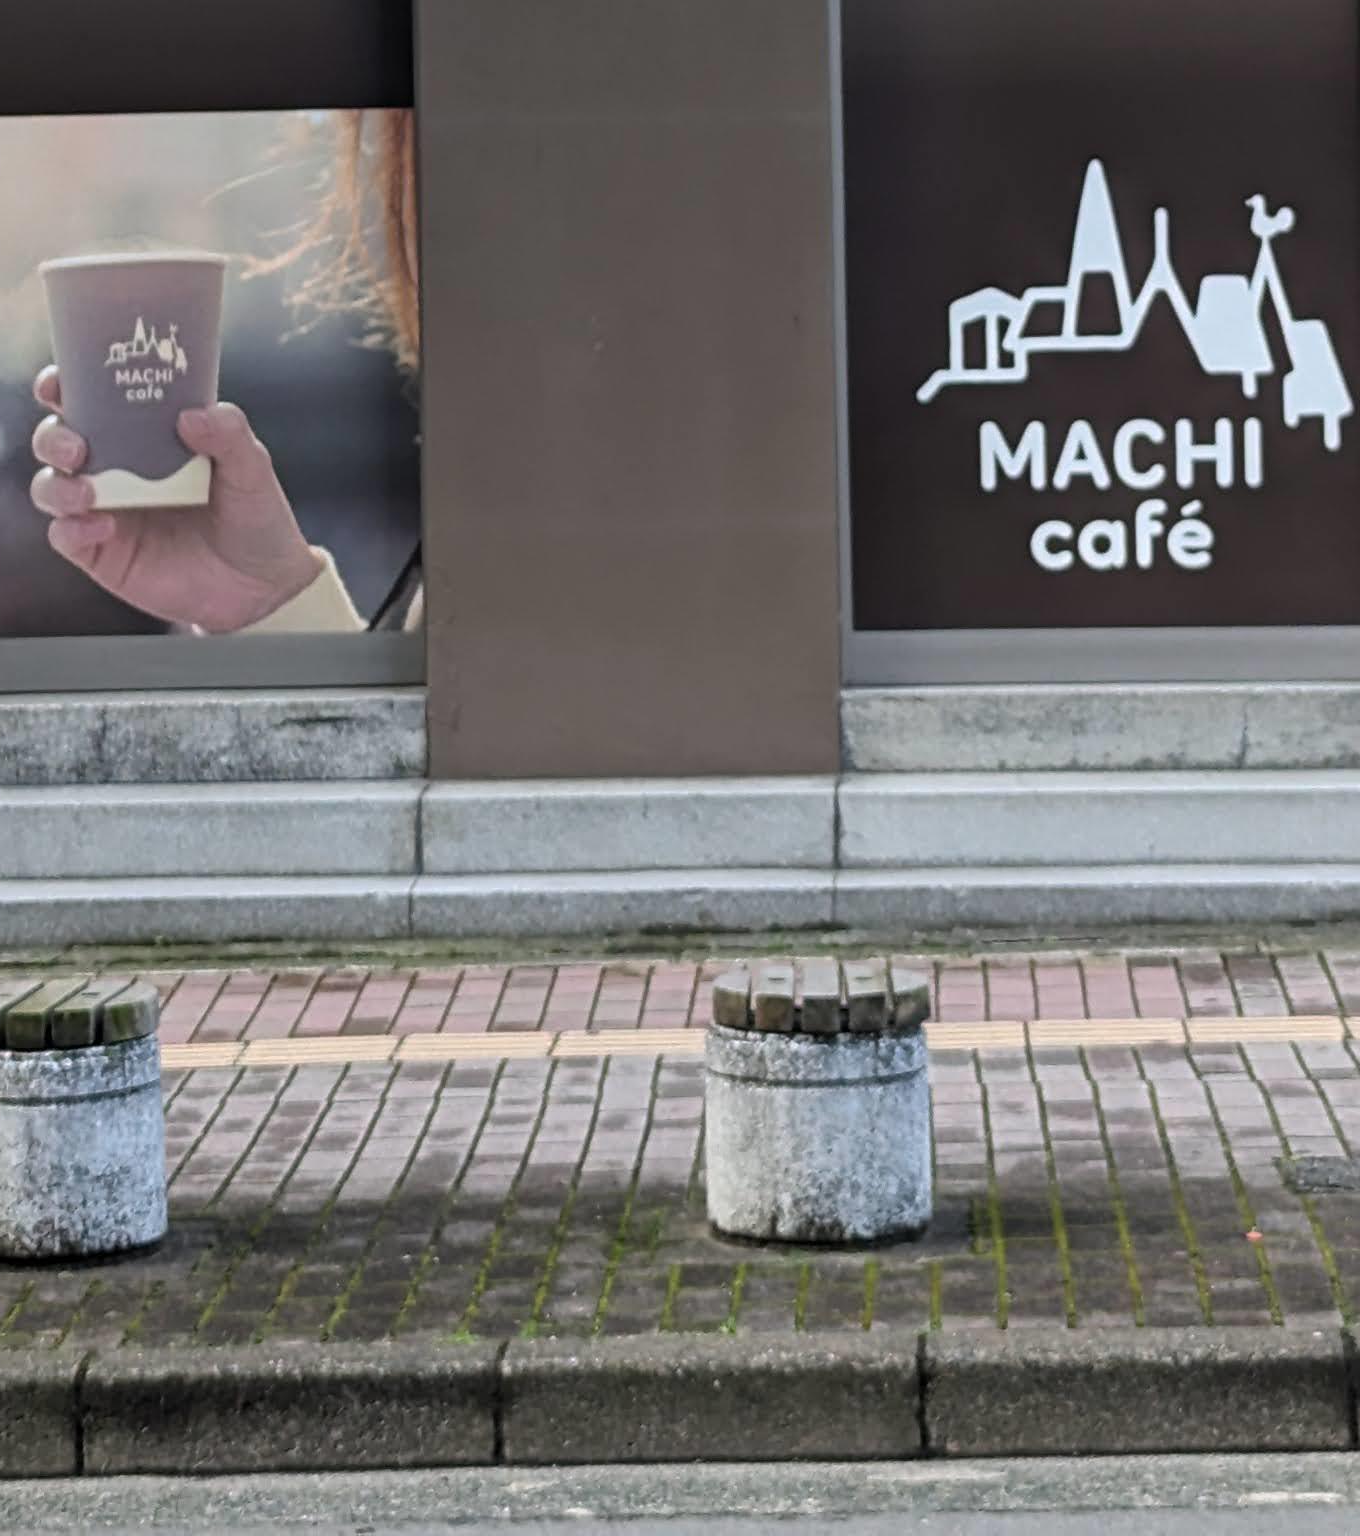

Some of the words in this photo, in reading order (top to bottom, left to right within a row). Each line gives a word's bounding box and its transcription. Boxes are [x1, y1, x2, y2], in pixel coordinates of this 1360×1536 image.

[115, 368, 173, 384] MACHI
[980, 417, 1262, 491] MACHI
[1030, 499, 1215, 569] café
